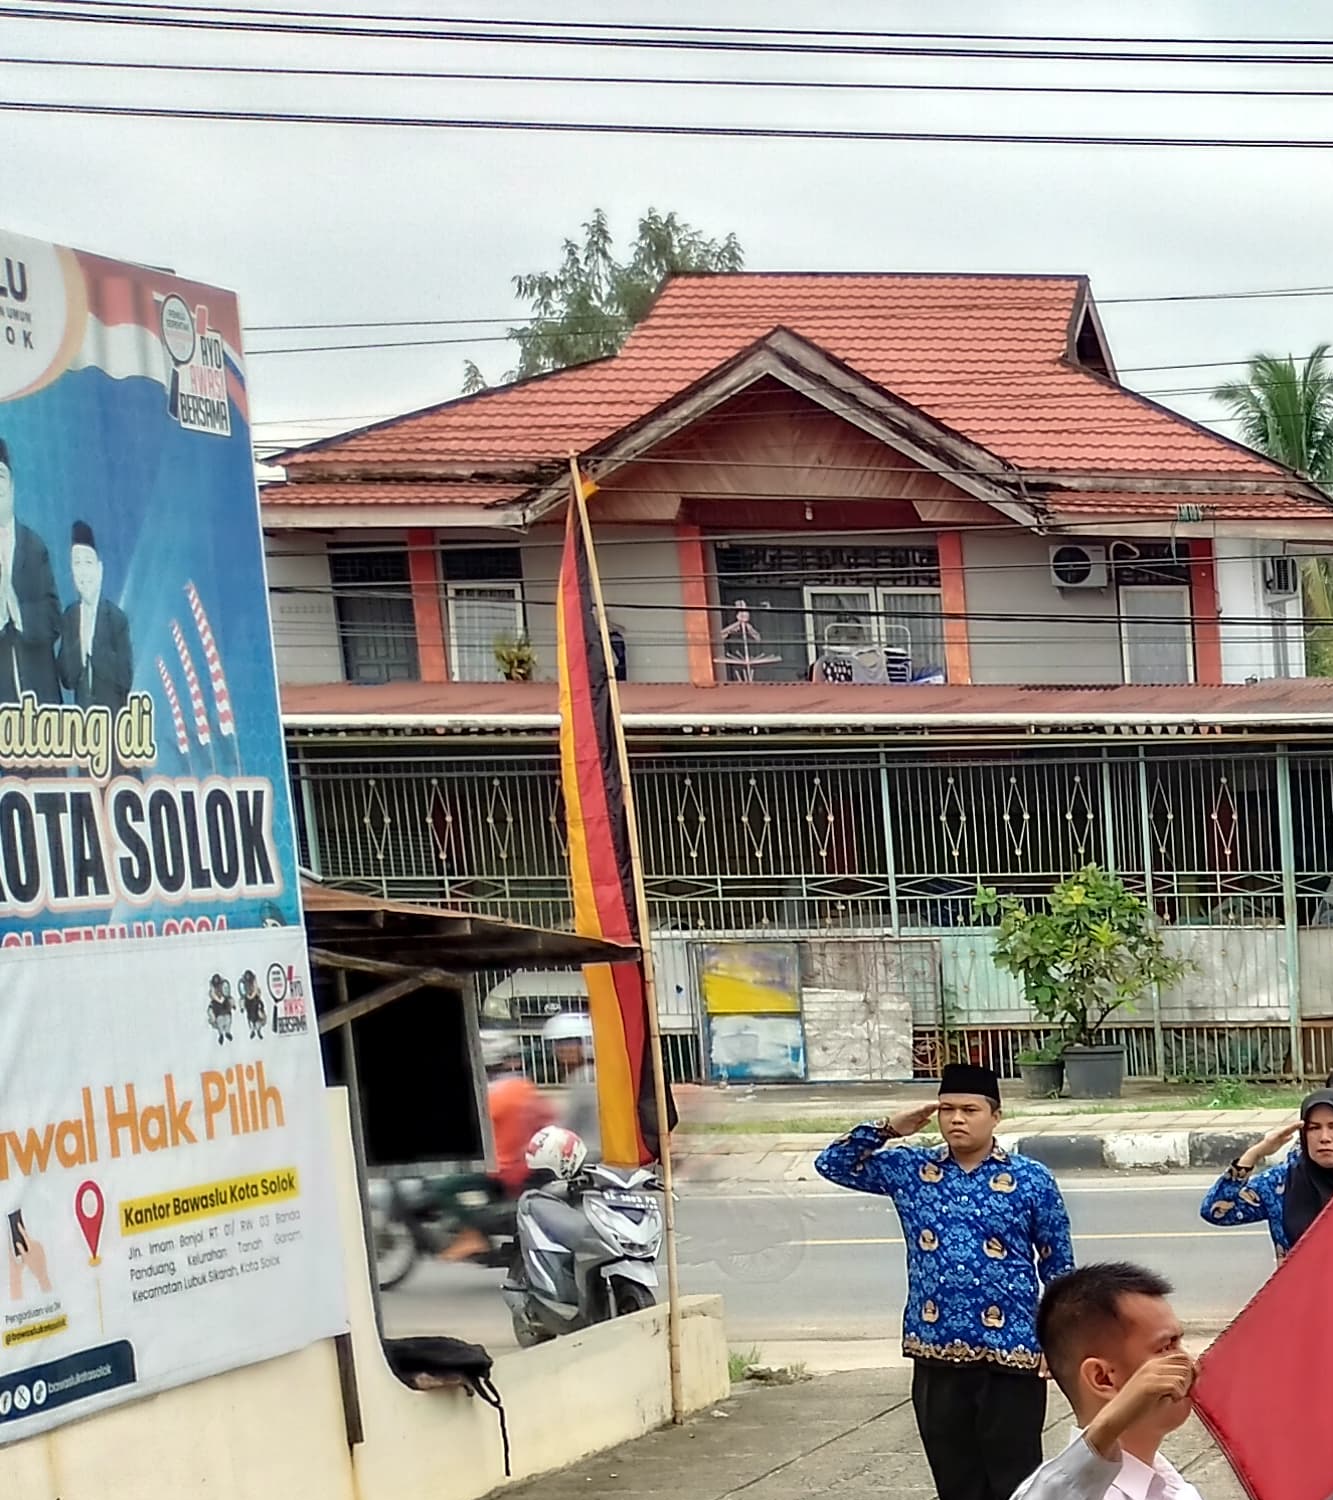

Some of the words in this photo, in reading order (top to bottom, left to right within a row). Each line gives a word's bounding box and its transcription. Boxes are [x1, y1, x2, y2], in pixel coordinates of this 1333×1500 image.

[0, 257, 27, 302] U
[200, 336, 222, 369] AYO
[180, 393, 229, 431] BERSAMA
[116, 693, 155, 760] di
[0, 791, 111, 903] OTA
[114, 788, 275, 895] SOLOK
[104, 1074, 198, 1159] Hak
[200, 1060, 286, 1141] Pilih
[124, 1202, 171, 1228] Kantor
[173, 1187, 228, 1216] Bawaslu
[229, 1181, 259, 1203] Kota
[260, 1173, 295, 1196] Solok
[149, 1238, 175, 1255] Imam
[179, 1230, 204, 1248] Bonjol
[132, 1280, 183, 1304] Kecamatan
[184, 1273, 208, 1290] Lubuk
